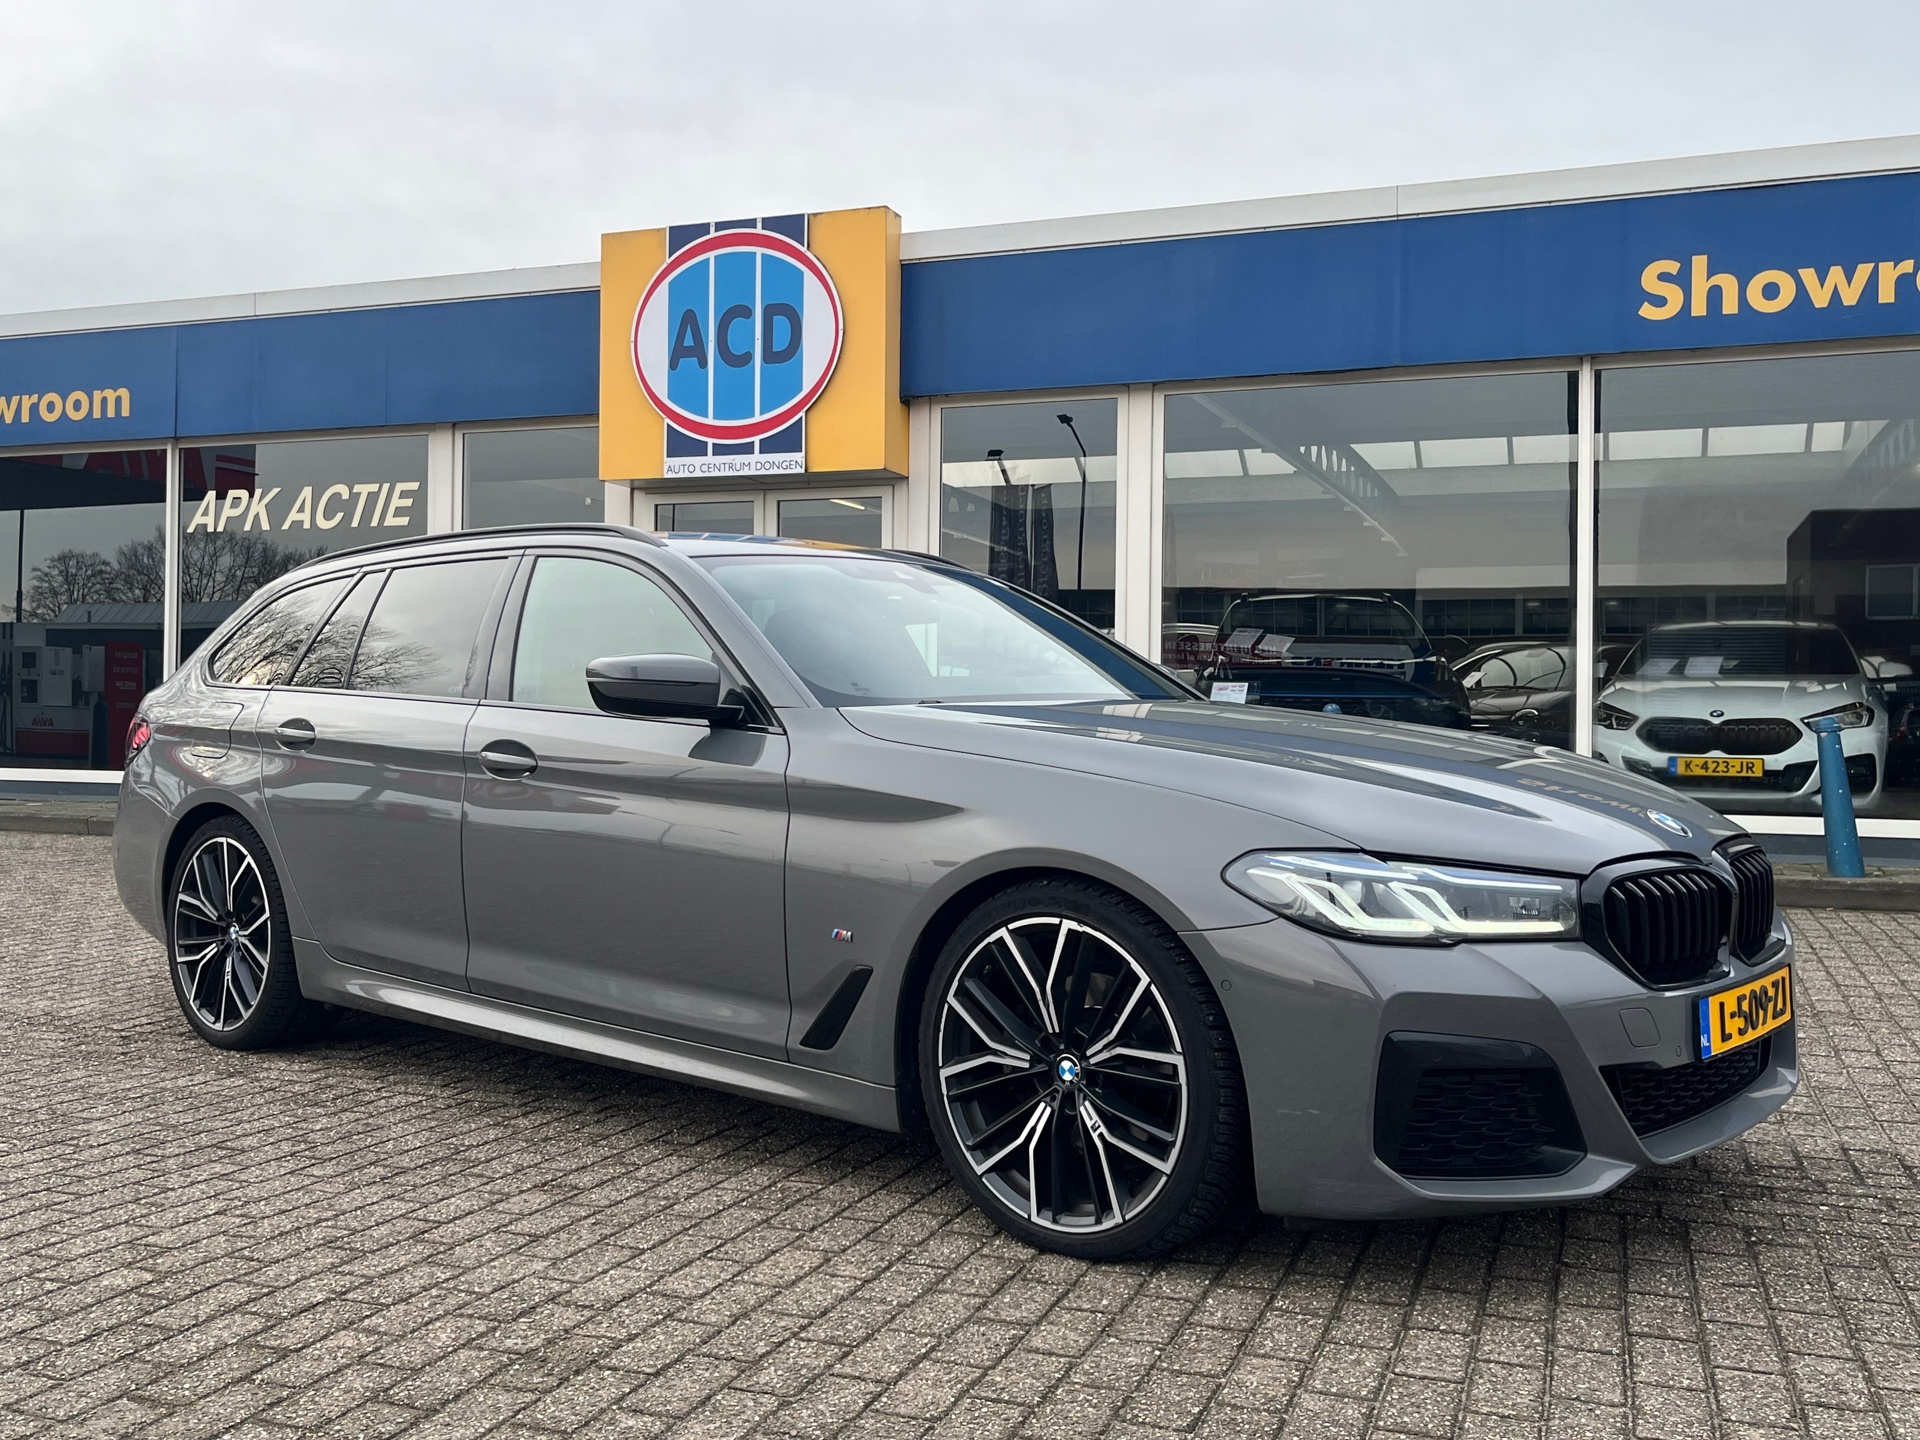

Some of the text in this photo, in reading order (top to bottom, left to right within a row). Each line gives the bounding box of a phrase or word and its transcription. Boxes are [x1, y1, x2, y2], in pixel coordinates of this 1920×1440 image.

[669, 302, 803, 372] ACD
[666, 459, 803, 474] AUTO CENTRUM DONGEN
[187, 481, 420, 533] APK ACTIE
[1683, 761, 1756, 775] K-423-JR
[1719, 975, 1787, 1044] L-509-ZJ
[1700, 1033, 1710, 1049] NL
